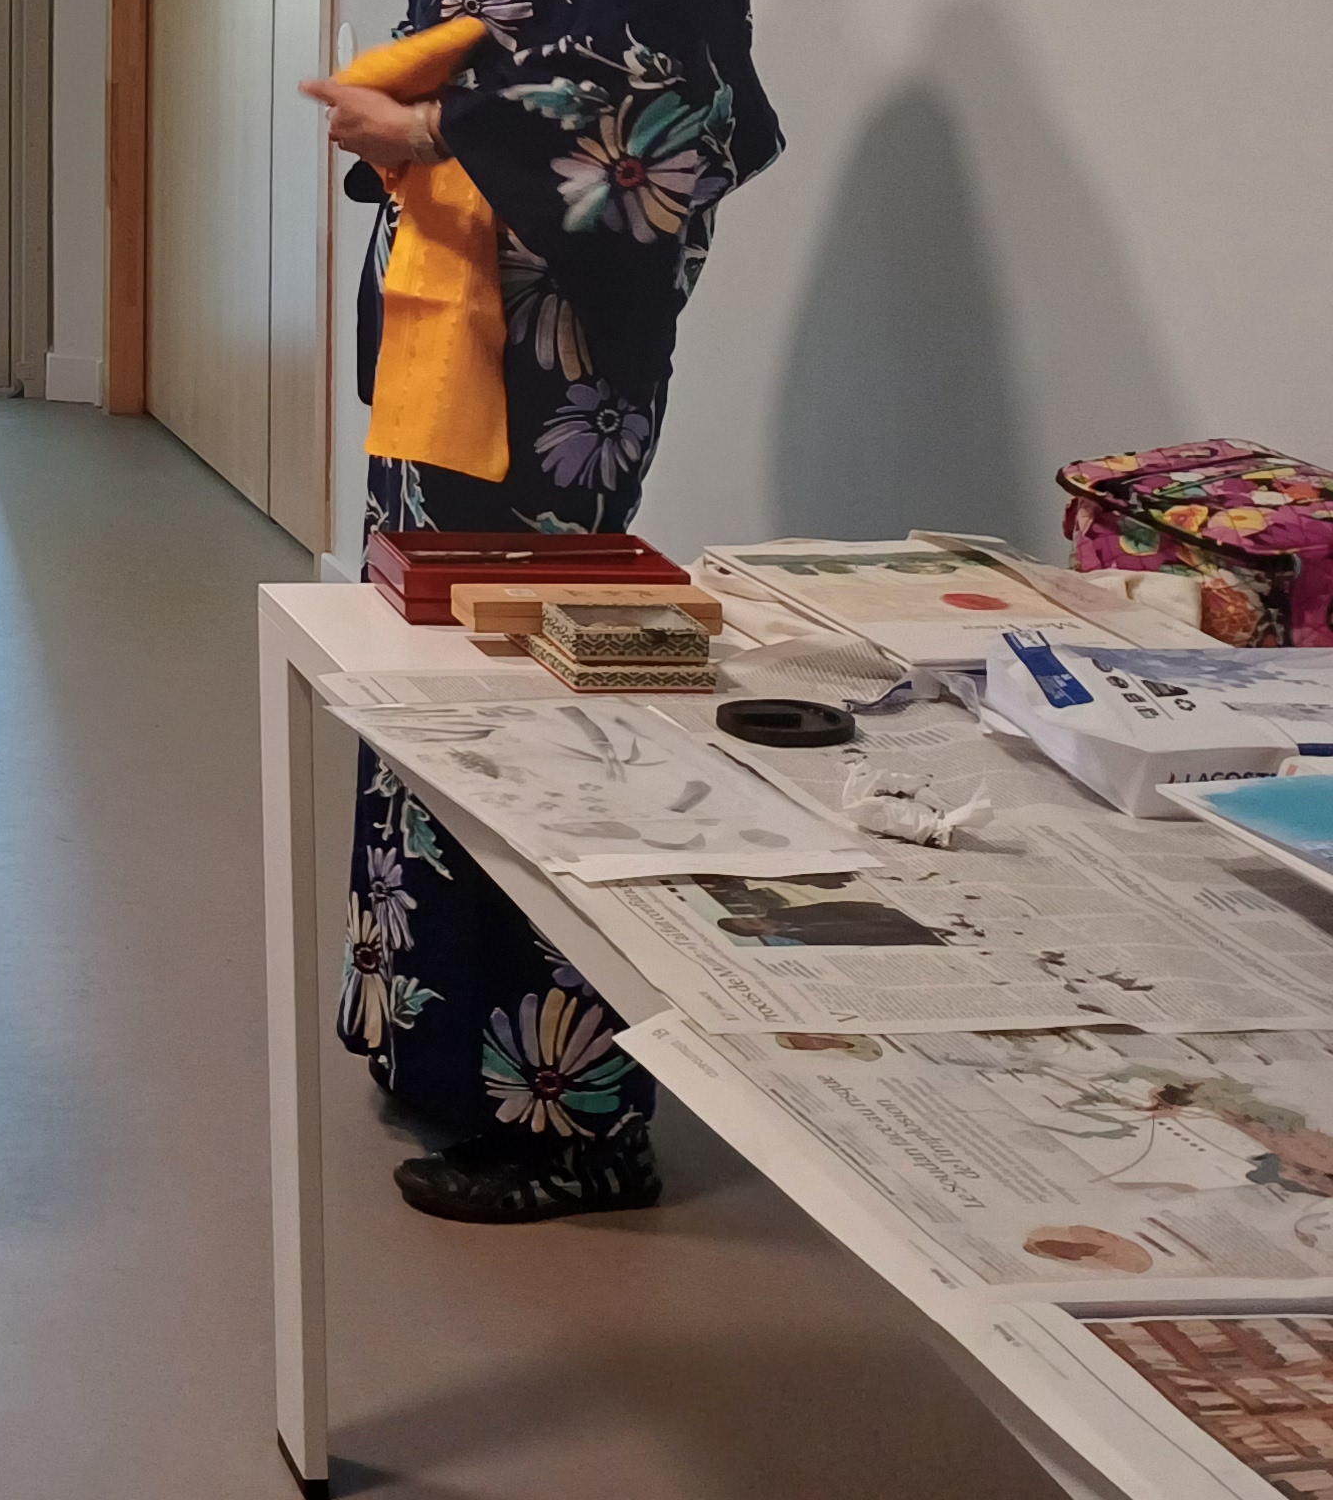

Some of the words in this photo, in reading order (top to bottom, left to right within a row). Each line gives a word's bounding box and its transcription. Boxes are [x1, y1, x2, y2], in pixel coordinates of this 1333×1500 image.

[860, 1107, 883, 1126] au
[876, 1121, 911, 1148] face
[904, 1148, 961, 1194] Soudan
[953, 1164, 981, 1180] de
[958, 1193, 987, 1209] Le
